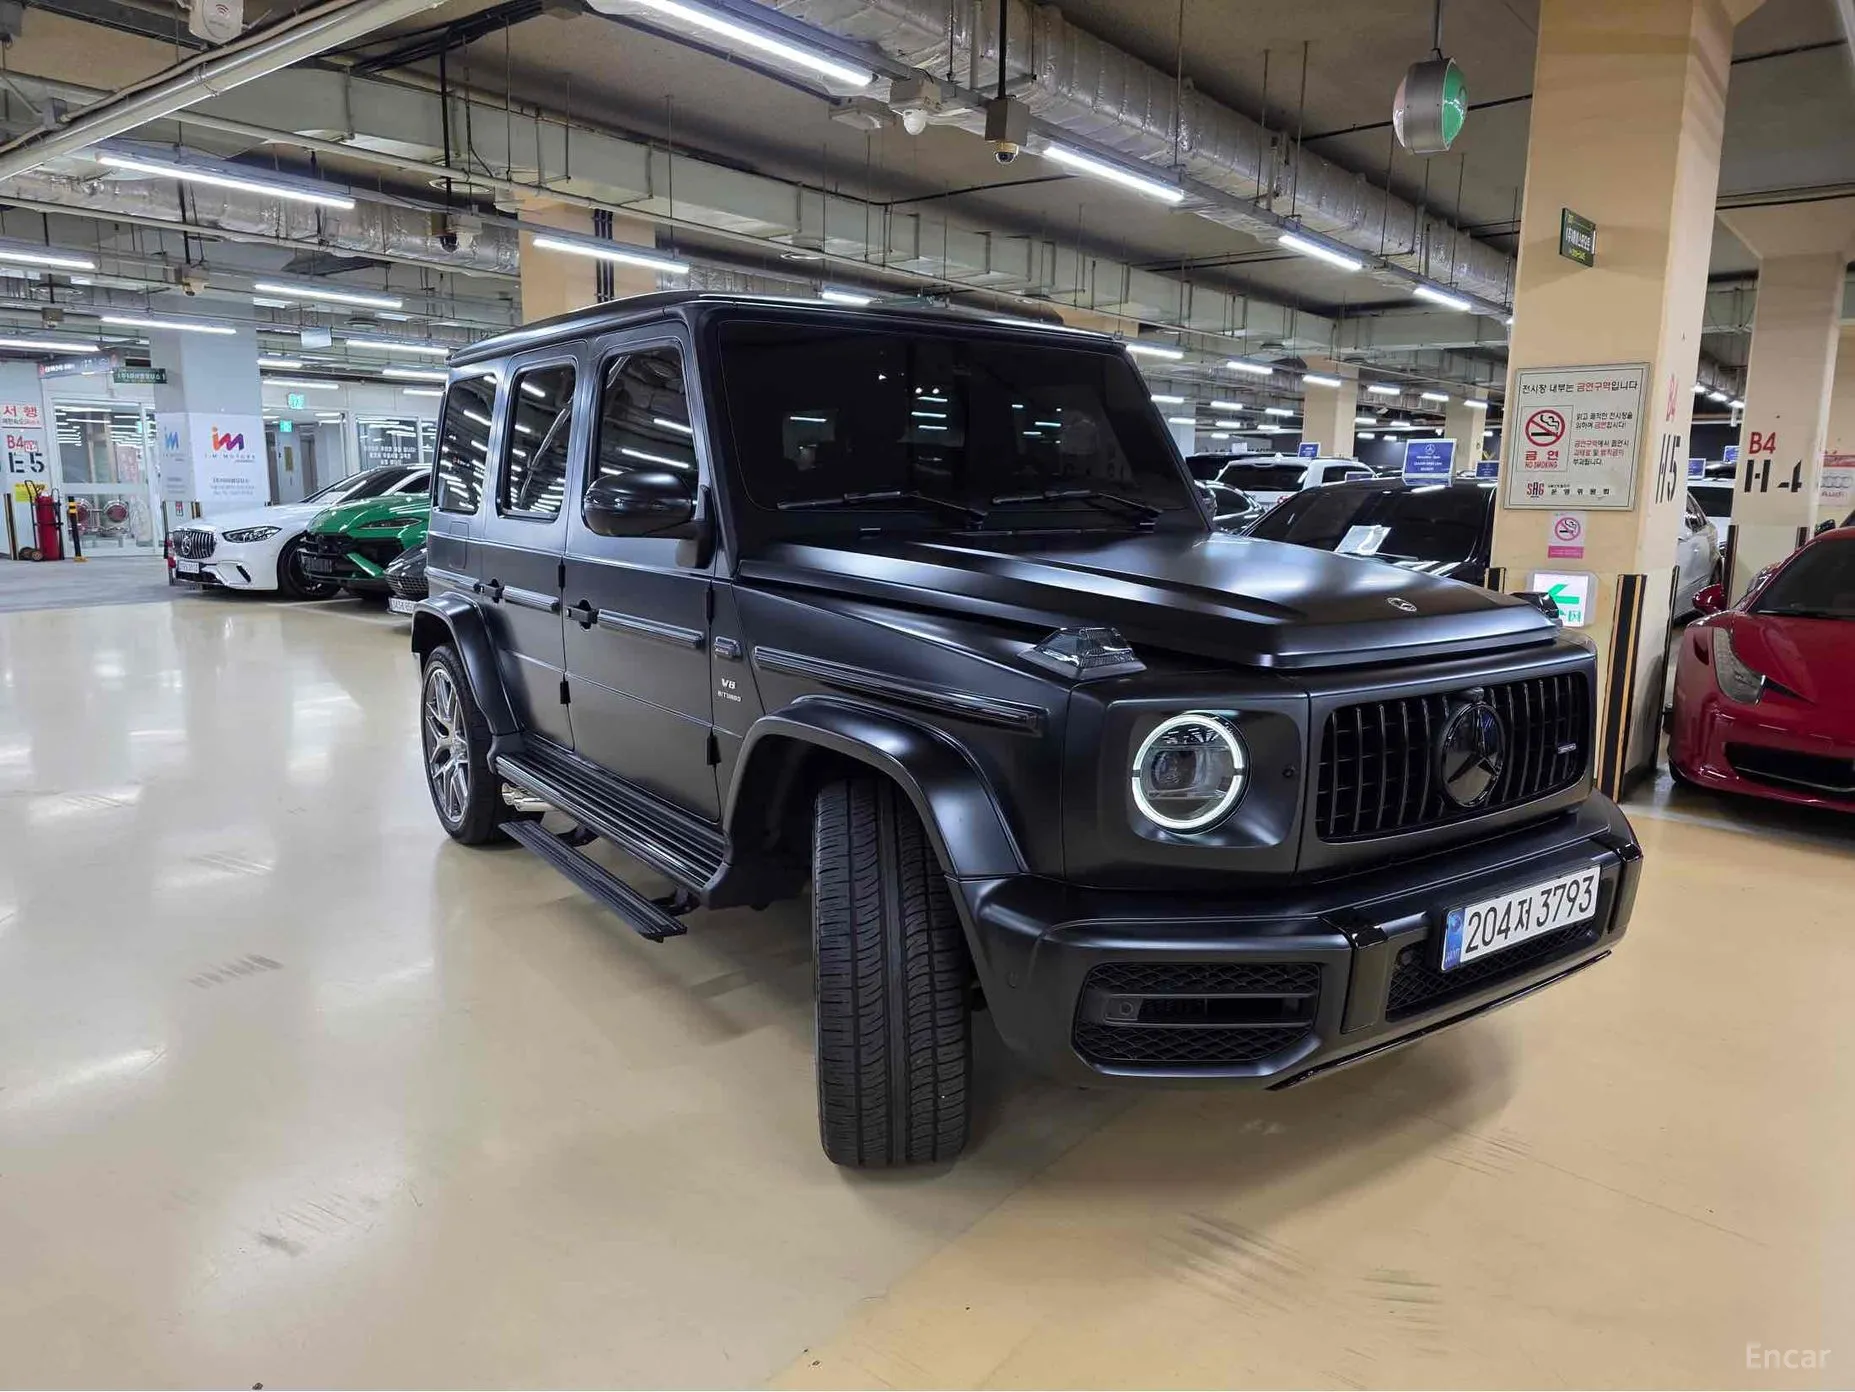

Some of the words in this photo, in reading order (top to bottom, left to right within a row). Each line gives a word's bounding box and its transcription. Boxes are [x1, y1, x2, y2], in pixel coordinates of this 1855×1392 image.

[1522, 384, 1547, 395] 전시장
[1549, 383, 1575, 393] 내부는
[1576, 380, 1638, 392] 금연구역입니다
[7, 434, 24, 449] B4
[1748, 432, 1777, 454] B4
